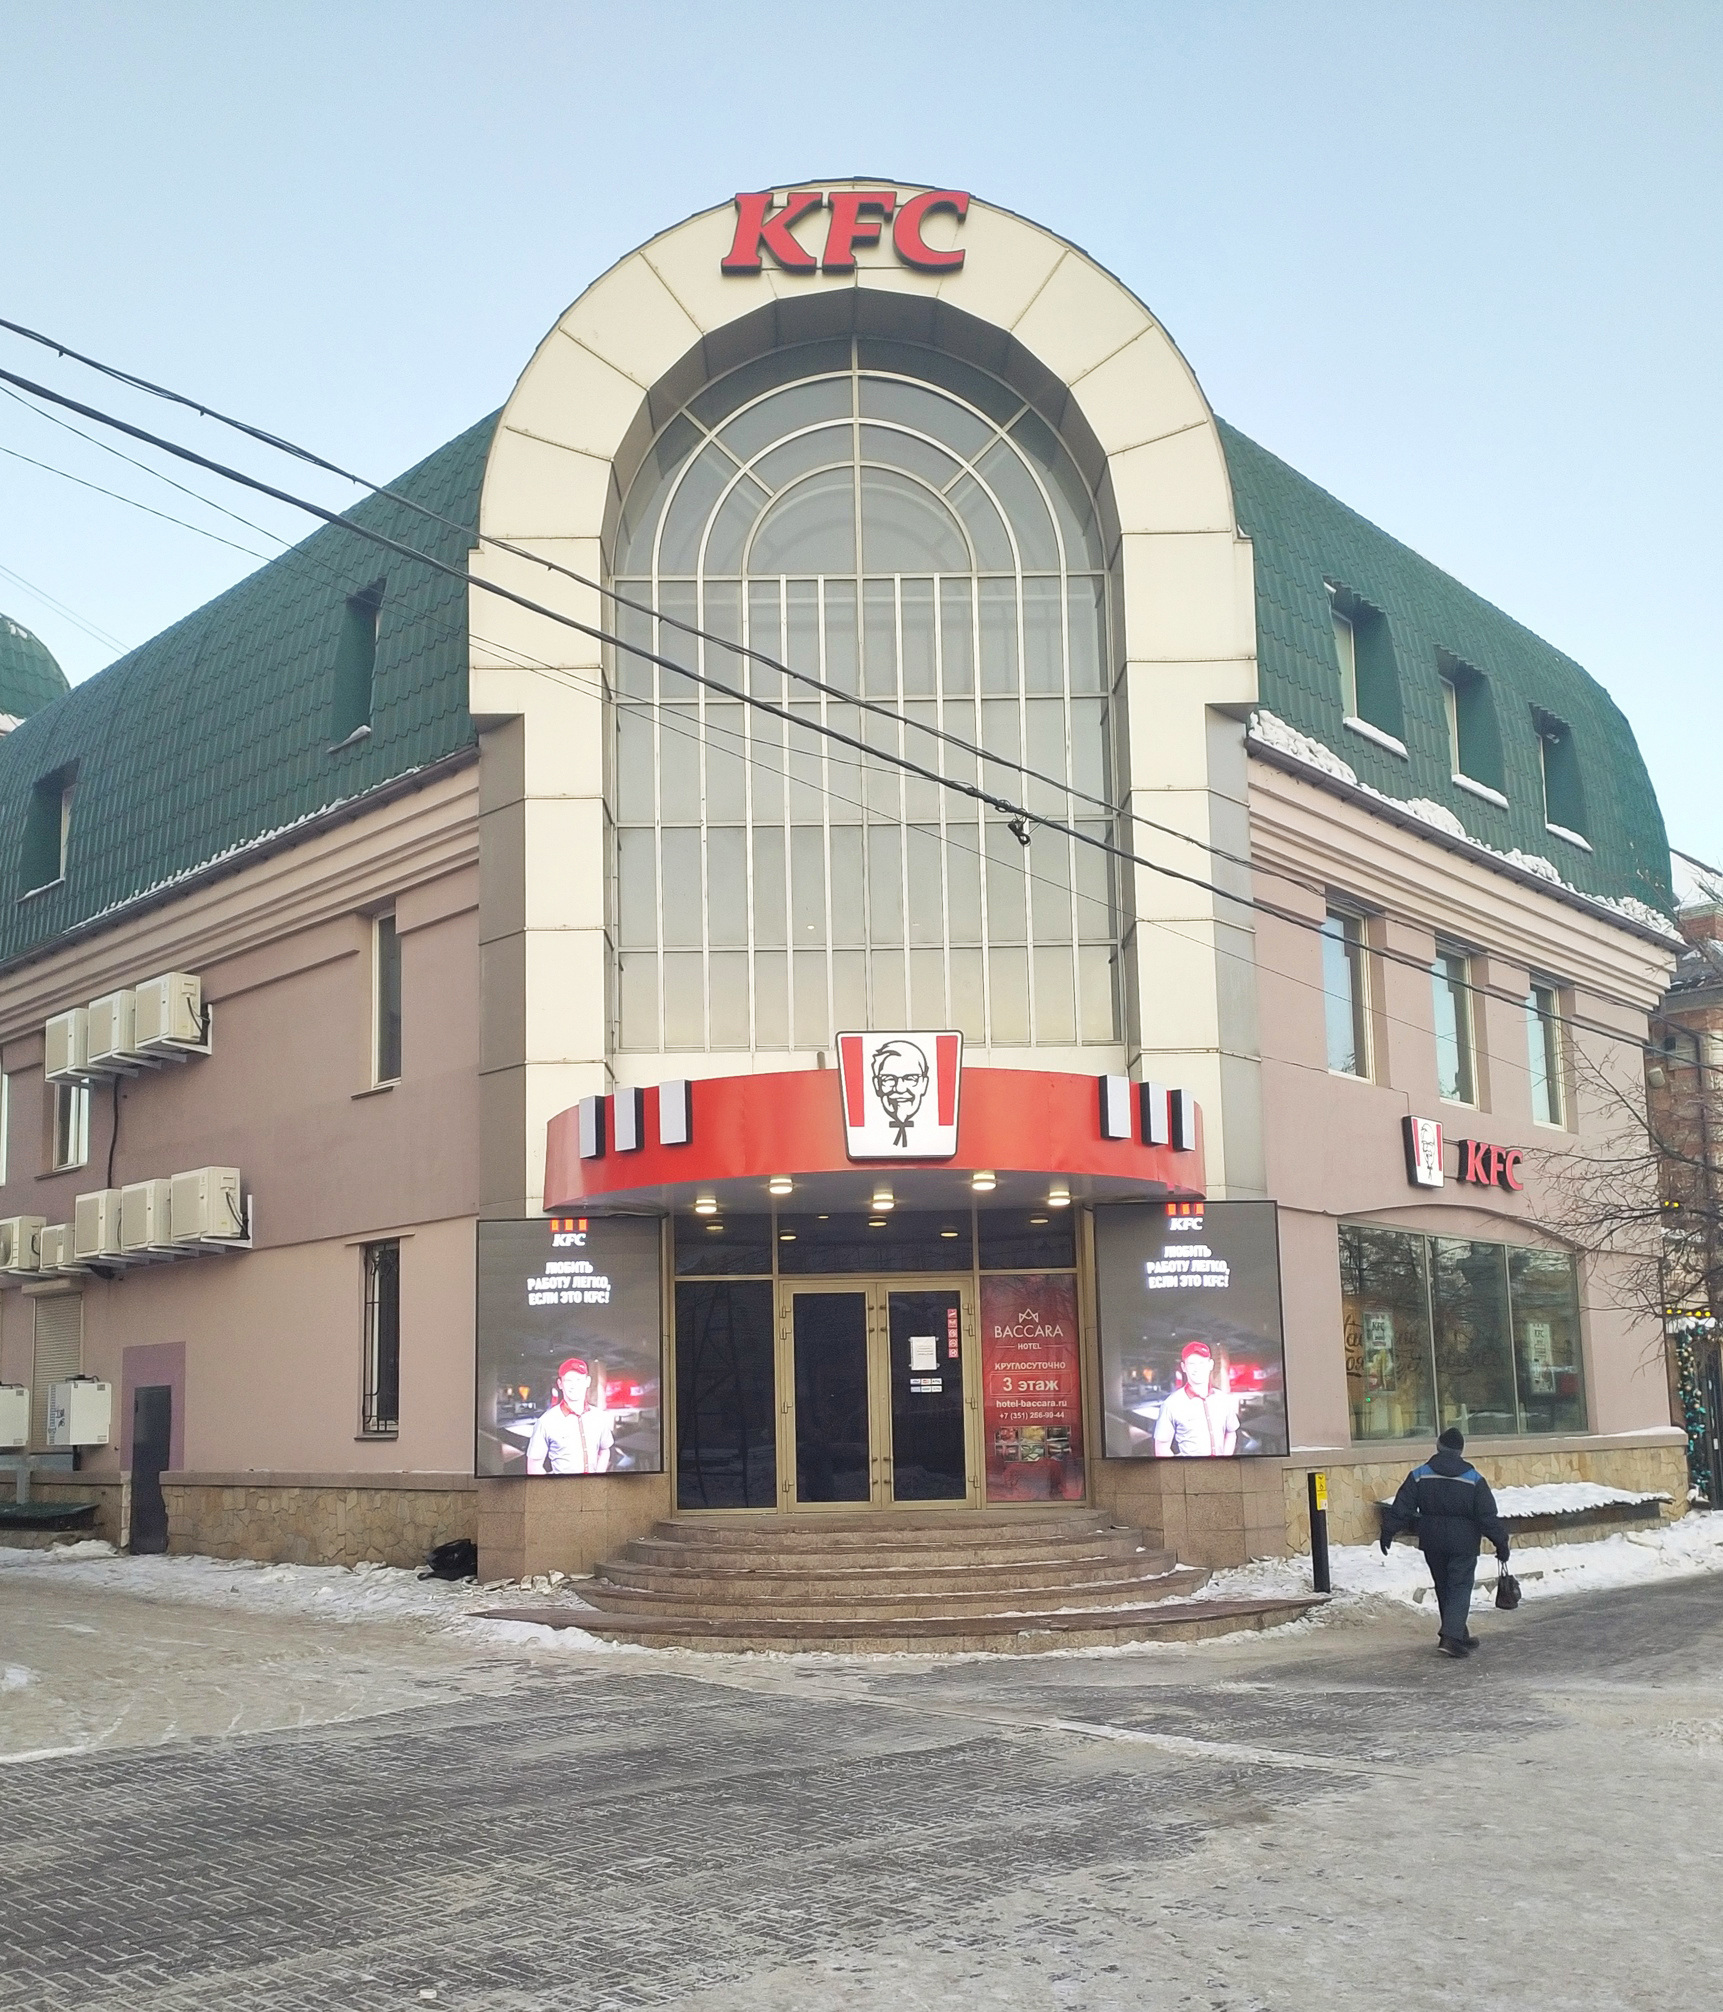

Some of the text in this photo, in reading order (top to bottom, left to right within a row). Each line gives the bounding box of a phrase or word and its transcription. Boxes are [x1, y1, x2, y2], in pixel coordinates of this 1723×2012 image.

[721, 191, 970, 272] KFC
[1464, 1140, 1523, 1191] KFC
[1170, 1217, 1203, 1231] KFC
[552, 1233, 587, 1247] KFC
[1164, 1245, 1212, 1258] ЛЮБИТЬ
[545, 1261, 594, 1275] ЛЮБИТЬ
[1146, 1260, 1230, 1275] РАБОТУ ЛЕГКО,
[527, 1276, 611, 1291] РАБОТУ ЛЕГКО,
[1148, 1275, 1229, 1289] ЕСЛИ ЭТО KFC!
[528, 1291, 610, 1306] ЕСЛИ ЭТО KFC!
[994, 1324, 1063, 1338] BACCARA
[1017, 1342, 1042, 1350] HOTEL
[994, 1361, 1066, 1371] КРУГЛОСУТОЧНО
[1003, 1377, 1059, 1391] 3 этаж
[996, 1400, 1068, 1408] hotel-baccara.ru
